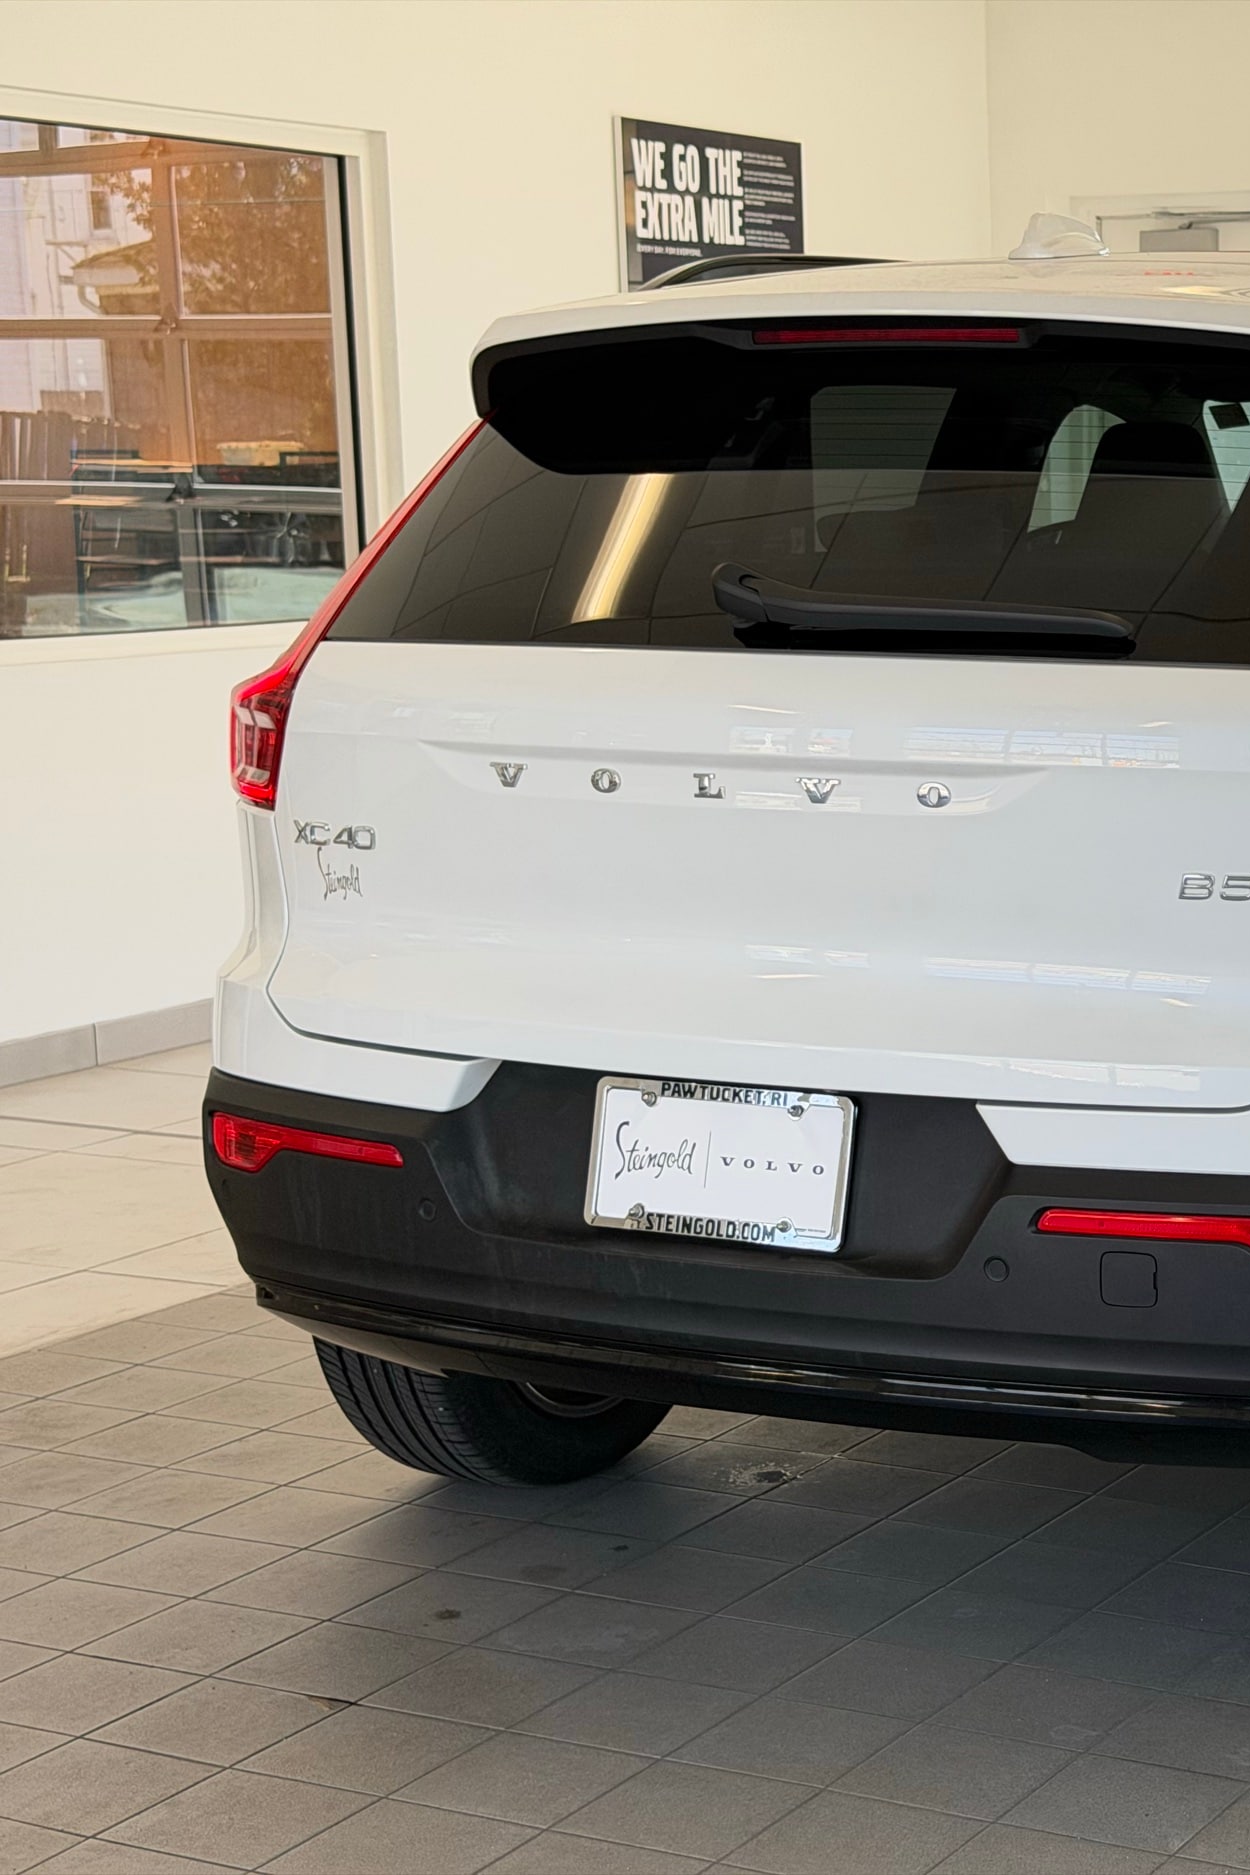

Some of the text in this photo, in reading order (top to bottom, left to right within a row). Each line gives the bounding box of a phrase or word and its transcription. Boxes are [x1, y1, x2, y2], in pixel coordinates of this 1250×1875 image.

[630, 137, 744, 197] WE GO THE
[634, 188, 699, 243] EXTRA
[701, 196, 745, 246] MILE
[490, 761, 952, 809] VOLVO
[293, 819, 376, 850] XC40
[317, 846, 363, 901] Steingold
[614, 1120, 825, 1180] Steingold VOLVO
[645, 1212, 777, 1243] STEINGOLD.COM
